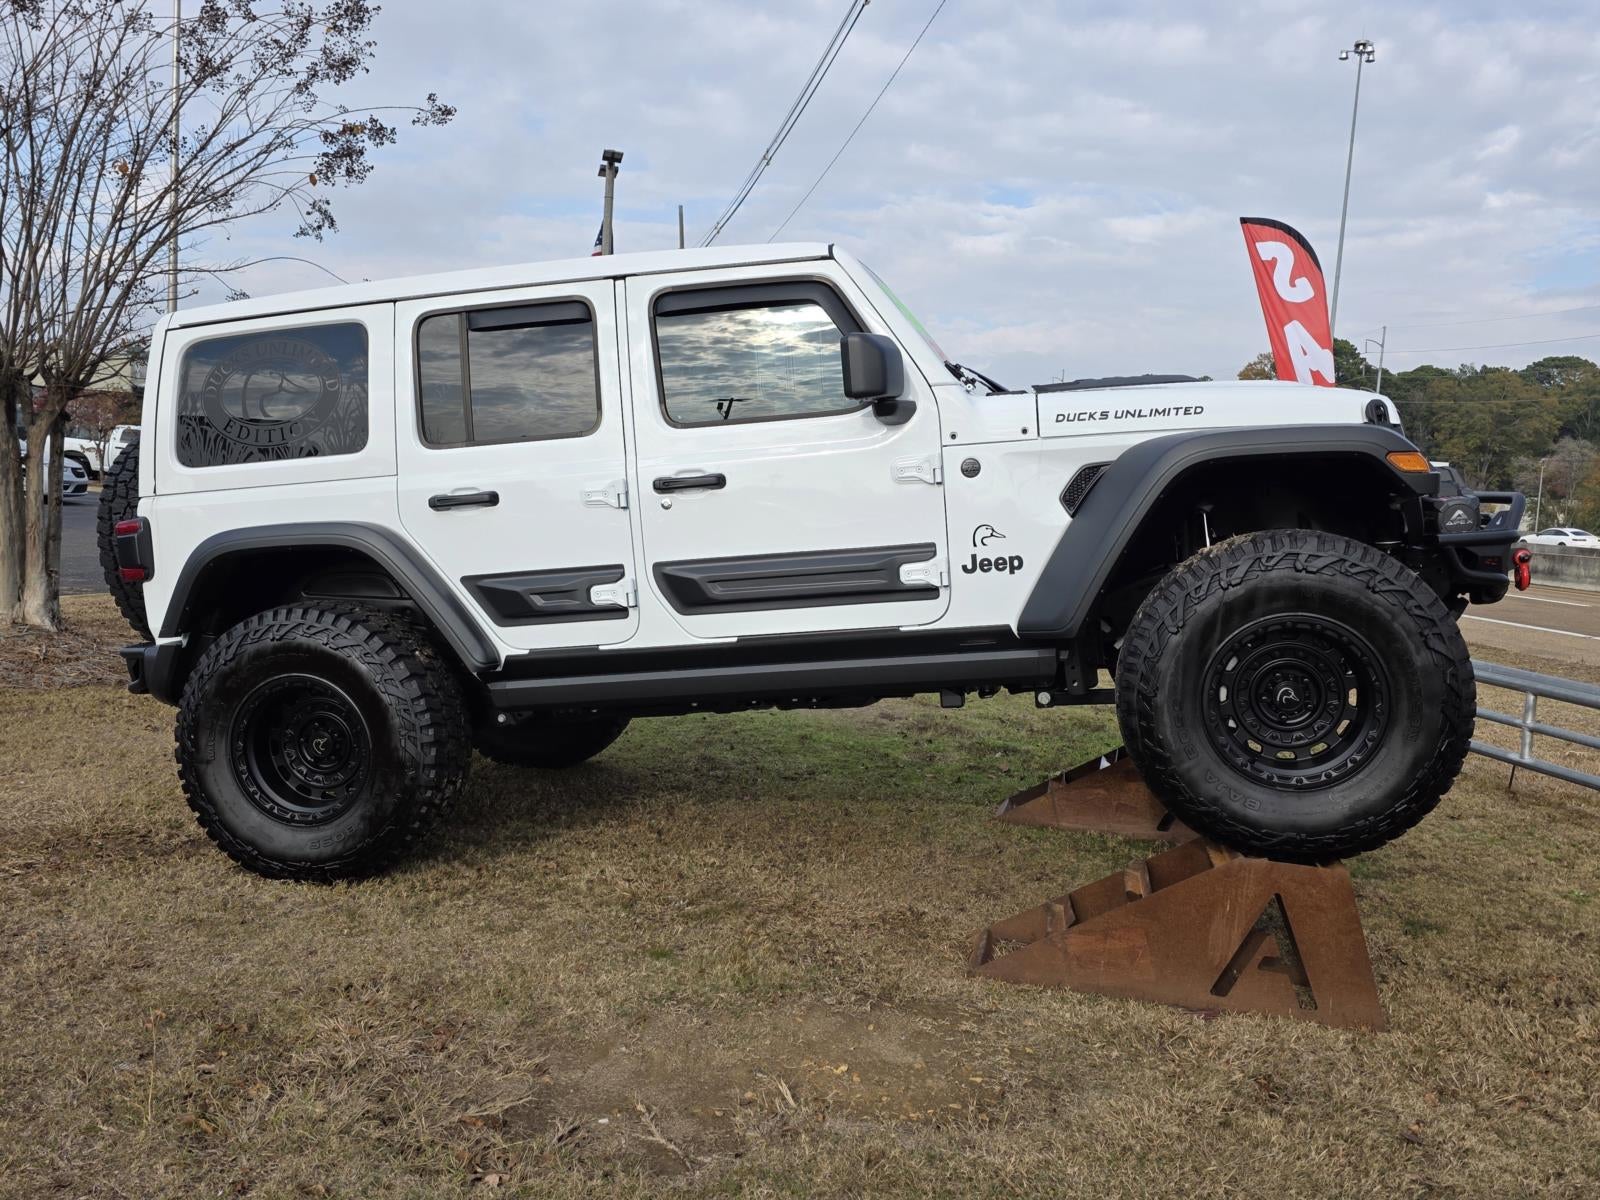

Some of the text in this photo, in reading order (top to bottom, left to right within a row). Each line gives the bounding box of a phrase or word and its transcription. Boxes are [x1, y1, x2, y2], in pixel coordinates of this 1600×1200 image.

[1055, 406, 1204, 423] DUCKS UNLIMITED
[961, 553, 1024, 575] Jeep
